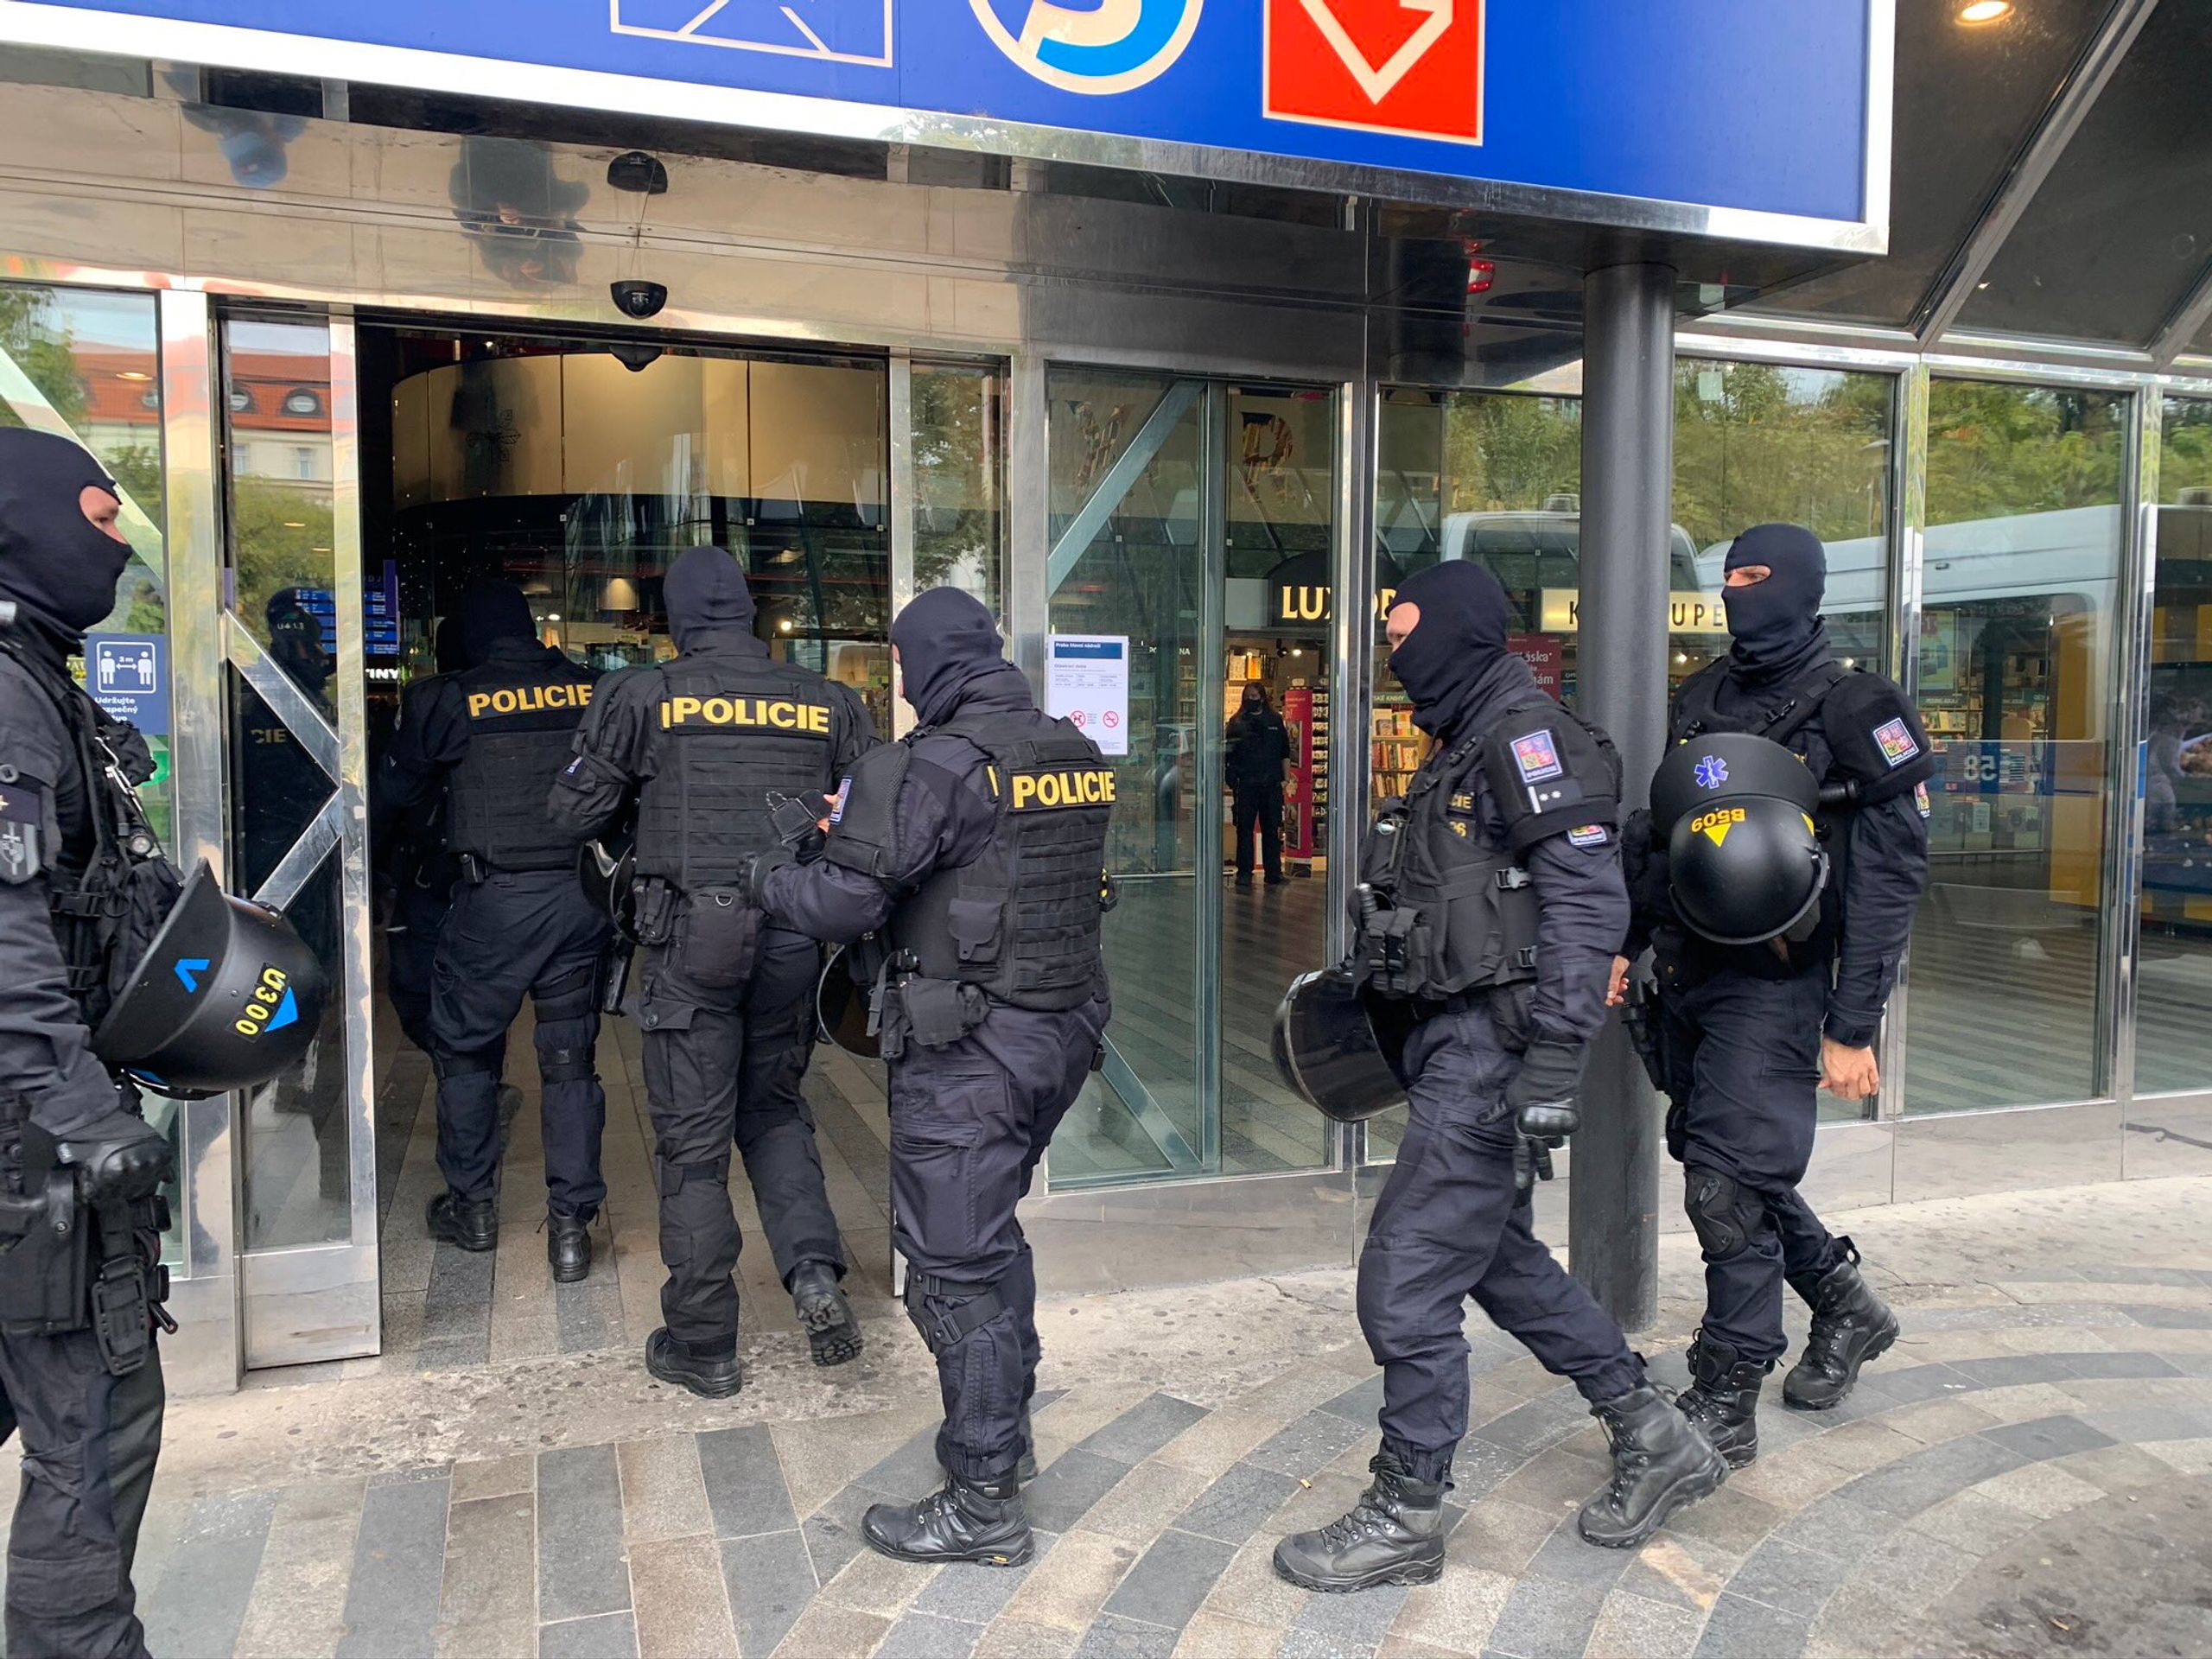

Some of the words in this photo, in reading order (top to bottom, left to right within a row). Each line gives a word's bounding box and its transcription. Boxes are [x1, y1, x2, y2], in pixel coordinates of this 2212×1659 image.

[468, 684, 593, 717] POLICIE
[672, 696, 830, 733] POLICIE
[1012, 771, 1116, 809] POLICIE
[1691, 808, 1746, 833] B509
[235, 968, 287, 1035] U300
